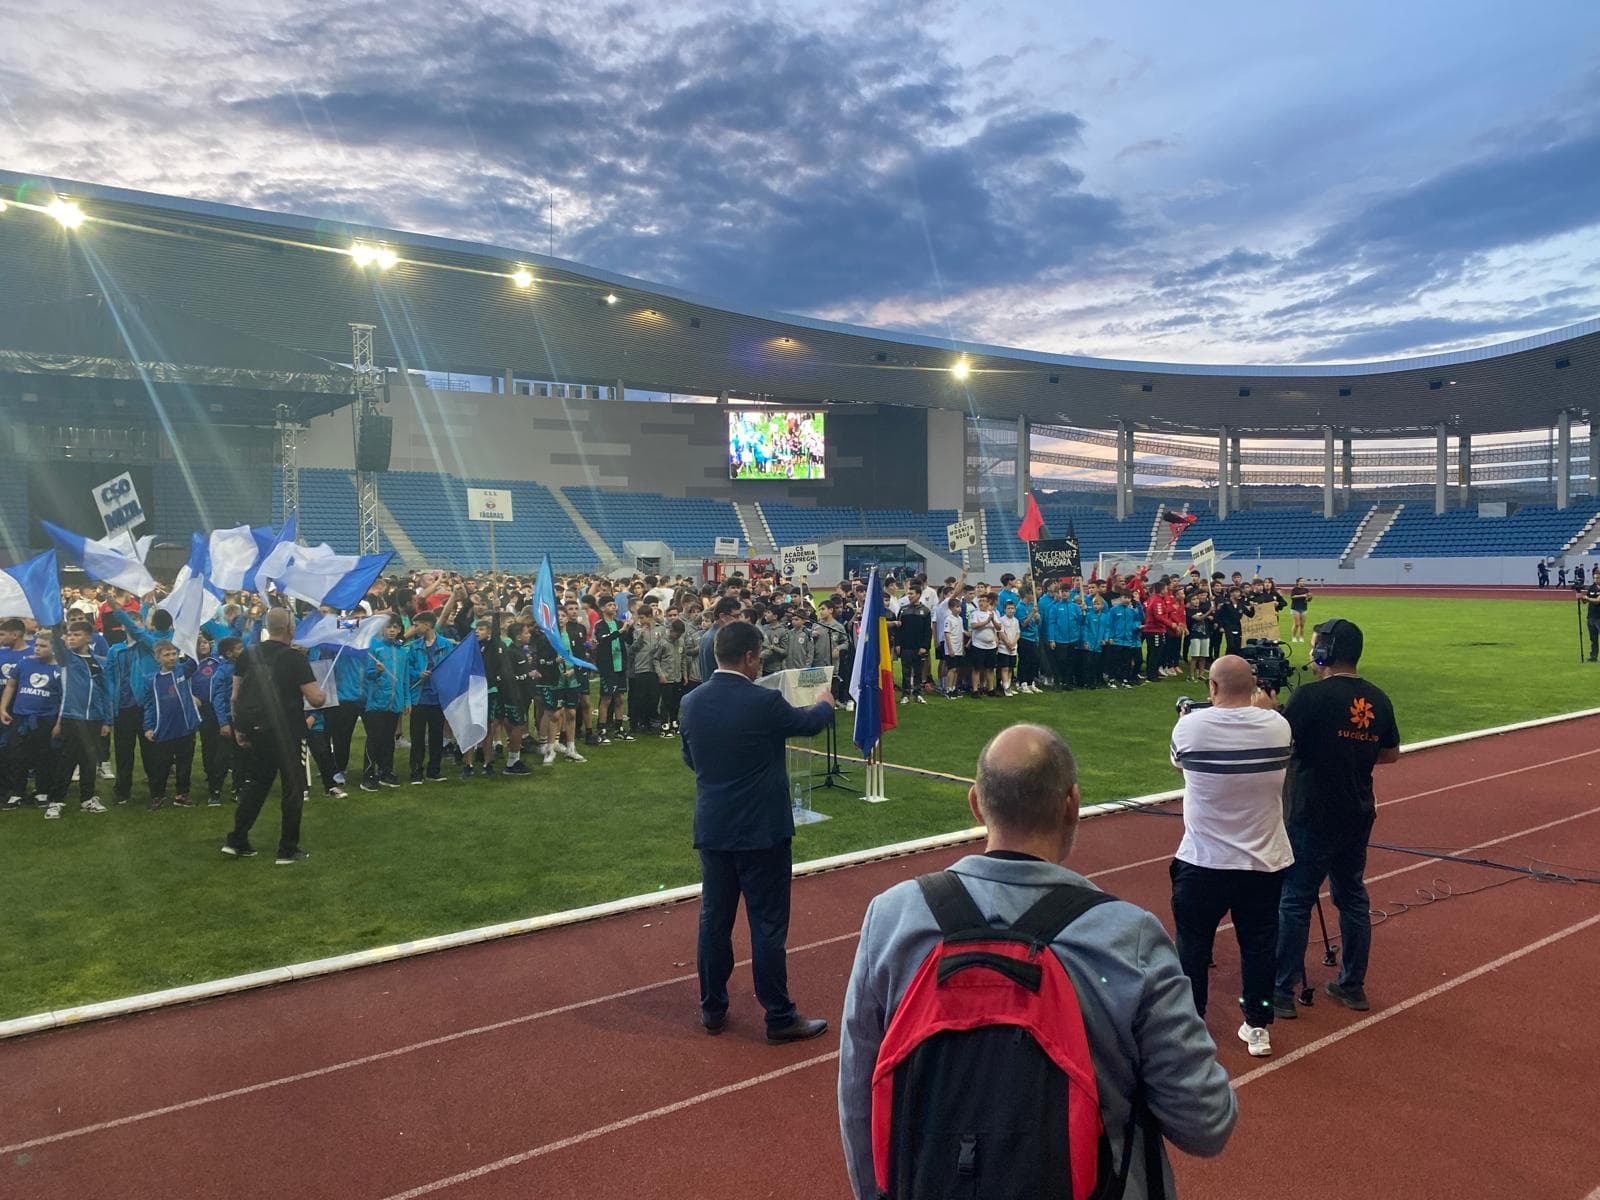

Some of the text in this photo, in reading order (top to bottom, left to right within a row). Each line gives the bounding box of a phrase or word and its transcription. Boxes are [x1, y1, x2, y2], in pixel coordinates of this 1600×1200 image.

[101, 479, 131, 505] CSO
[784, 550, 816, 558] ACADEMIA
[784, 555, 817, 564] CSEPREGHI
